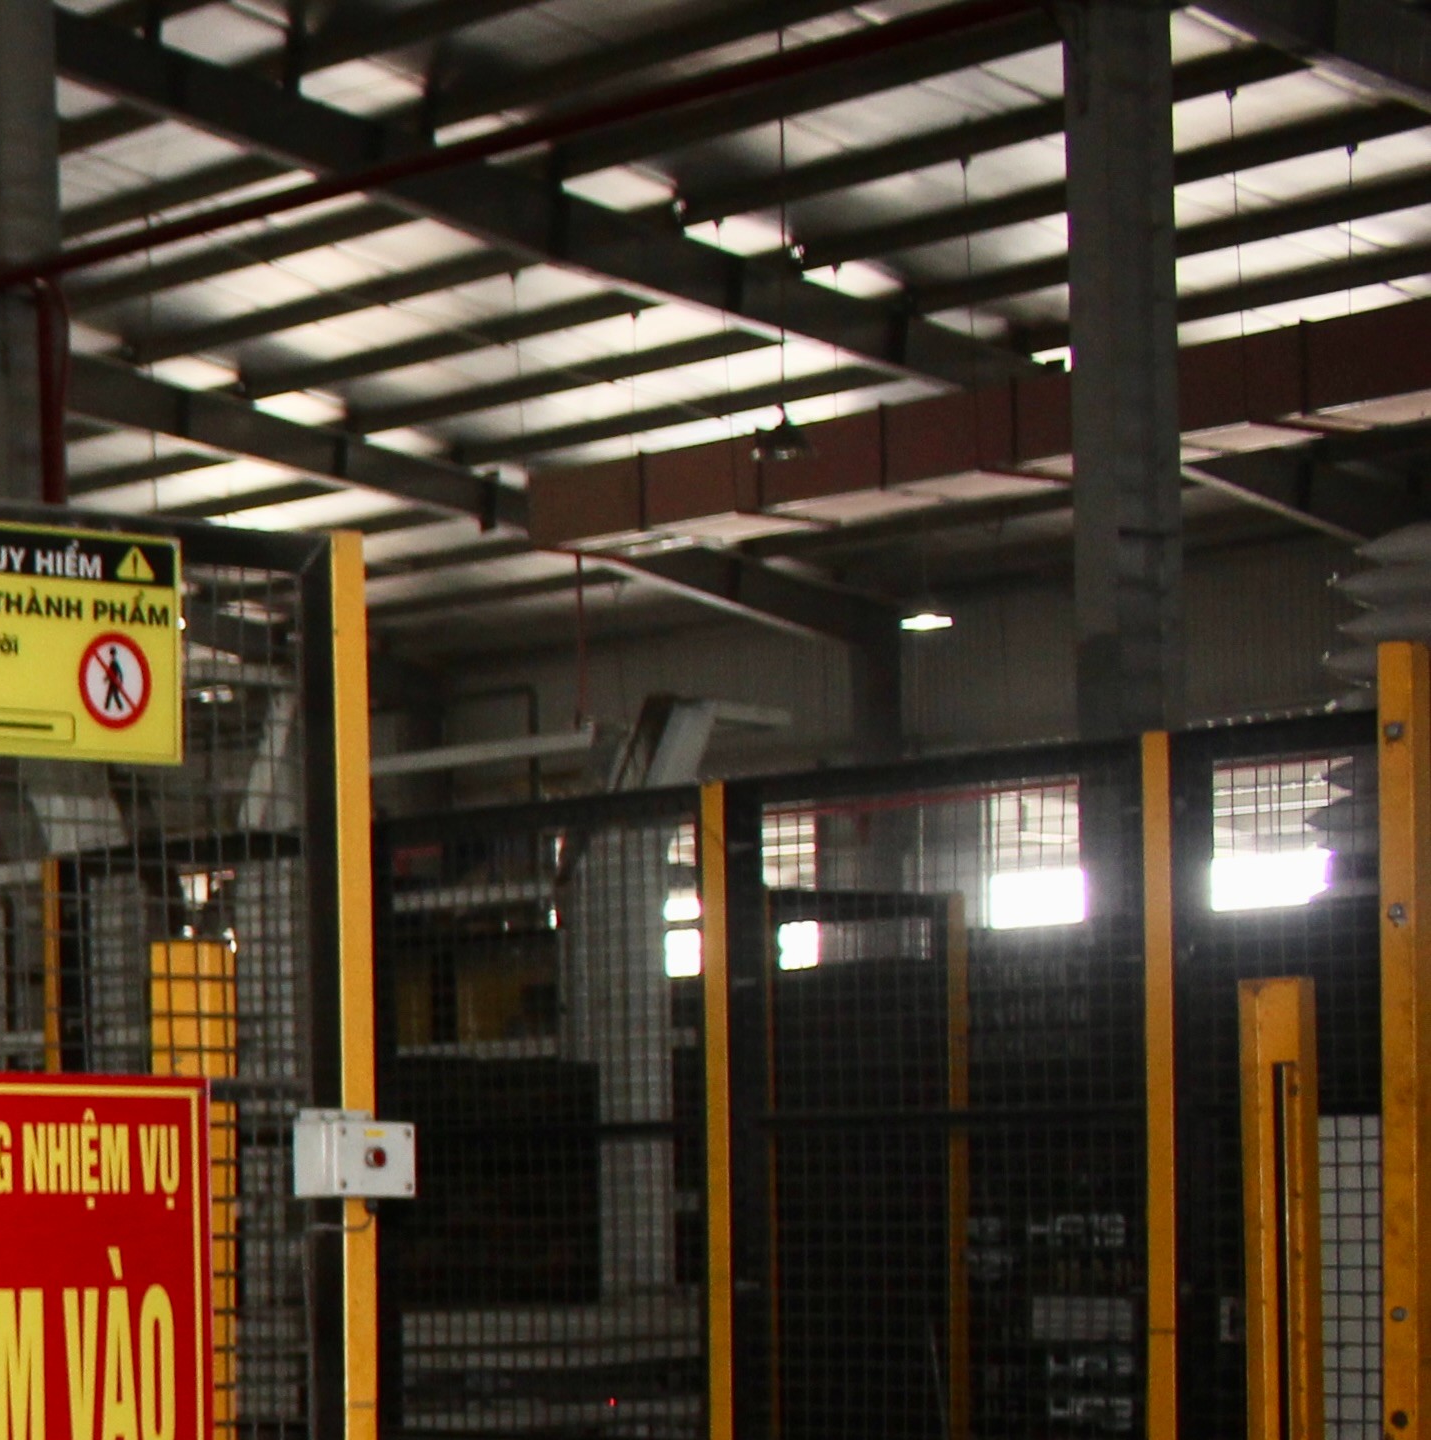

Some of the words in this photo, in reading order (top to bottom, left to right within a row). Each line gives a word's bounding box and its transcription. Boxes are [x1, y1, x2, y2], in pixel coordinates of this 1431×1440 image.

[33, 540, 103, 579] HIỂM
[93, 592, 170, 627] PHẨM
[23, 1109, 130, 1209] NHIỆM
[139, 1124, 181, 1209] VỤ
